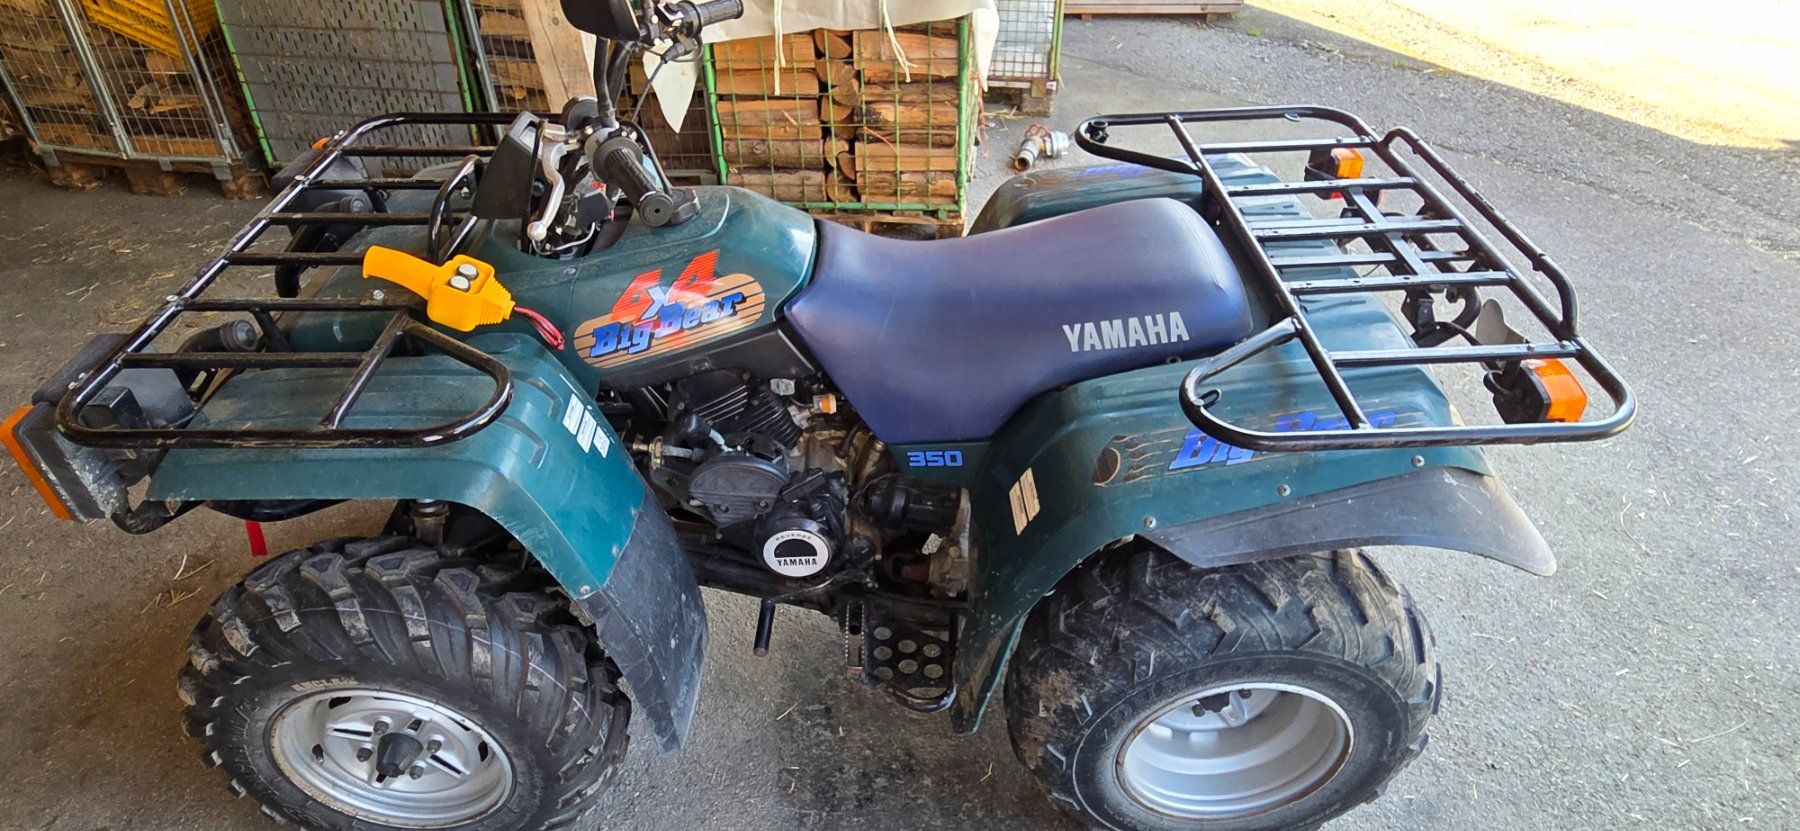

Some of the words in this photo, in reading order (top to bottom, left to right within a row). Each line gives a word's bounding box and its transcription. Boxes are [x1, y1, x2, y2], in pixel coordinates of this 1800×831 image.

[590, 321, 653, 358] Big
[654, 293, 747, 339] Bear
[1062, 311, 1190, 353] YAMAHA
[906, 450, 963, 467] 350
[777, 558, 818, 567] YAMAHA
